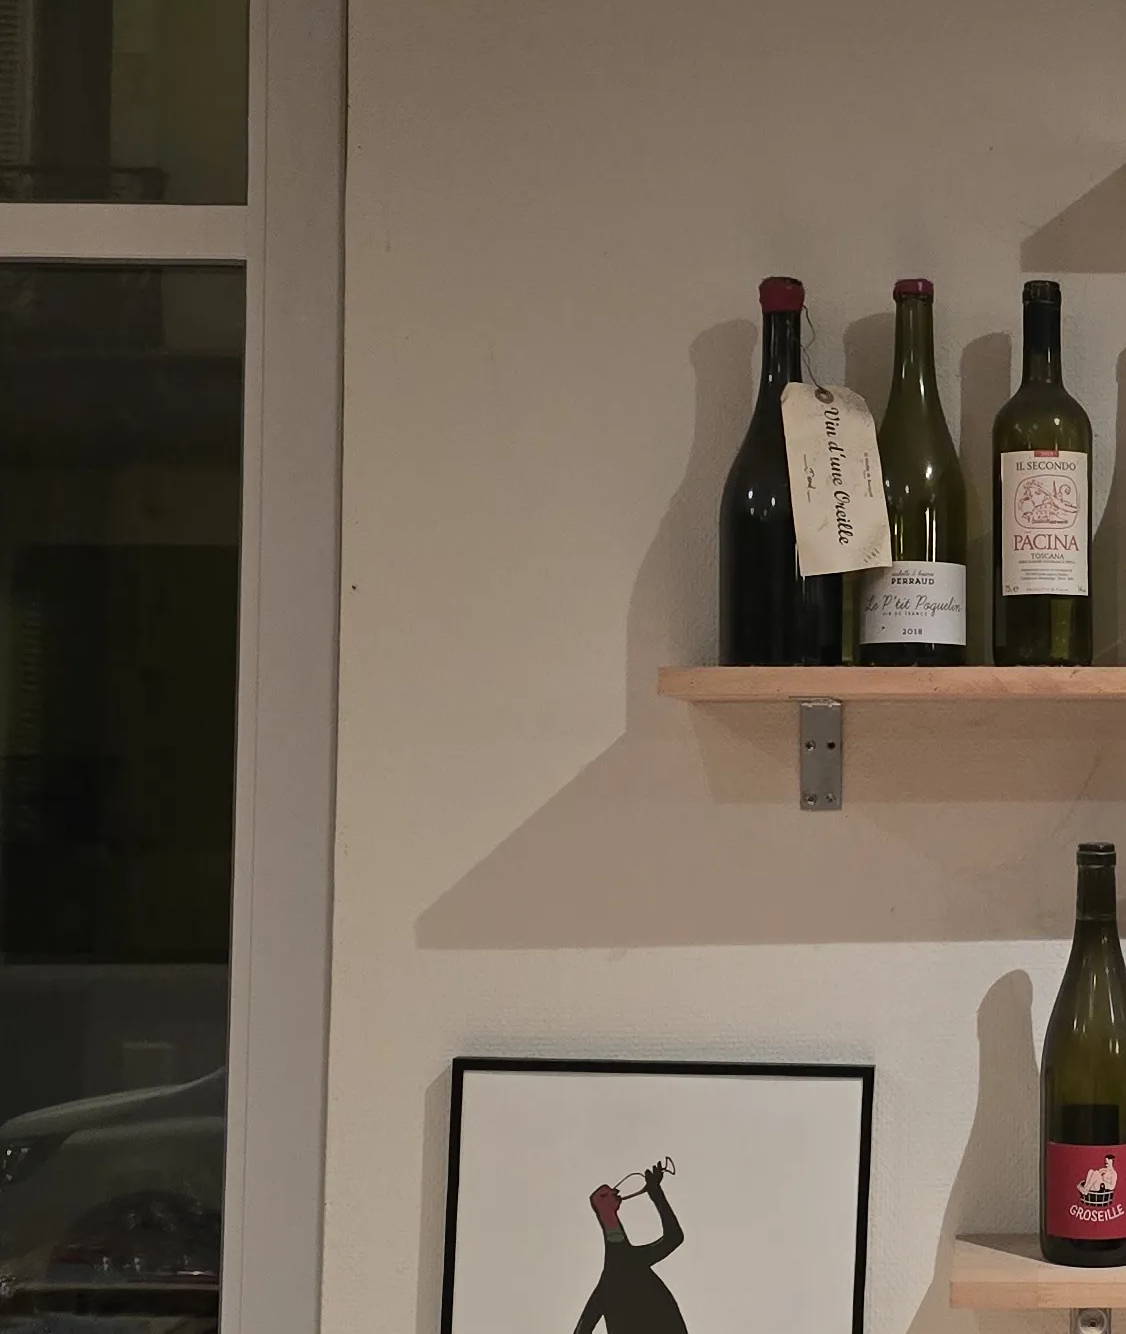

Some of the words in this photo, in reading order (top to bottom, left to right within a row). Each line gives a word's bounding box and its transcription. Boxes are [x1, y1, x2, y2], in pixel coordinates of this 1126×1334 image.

[824, 407, 841, 438] Vin
[827, 440, 846, 486] d'une
[1016, 461, 1025, 471] IL
[1027, 461, 1076, 471] SECONDO
[833, 490, 854, 545] Oreille
[1013, 533, 1079, 551] PACINA
[891, 577, 935, 585] PERRAUD
[864, 594, 879, 612] Le
[882, 594, 911, 611] P'tit
[1069, 1204, 1125, 1222] GROSEILLE
